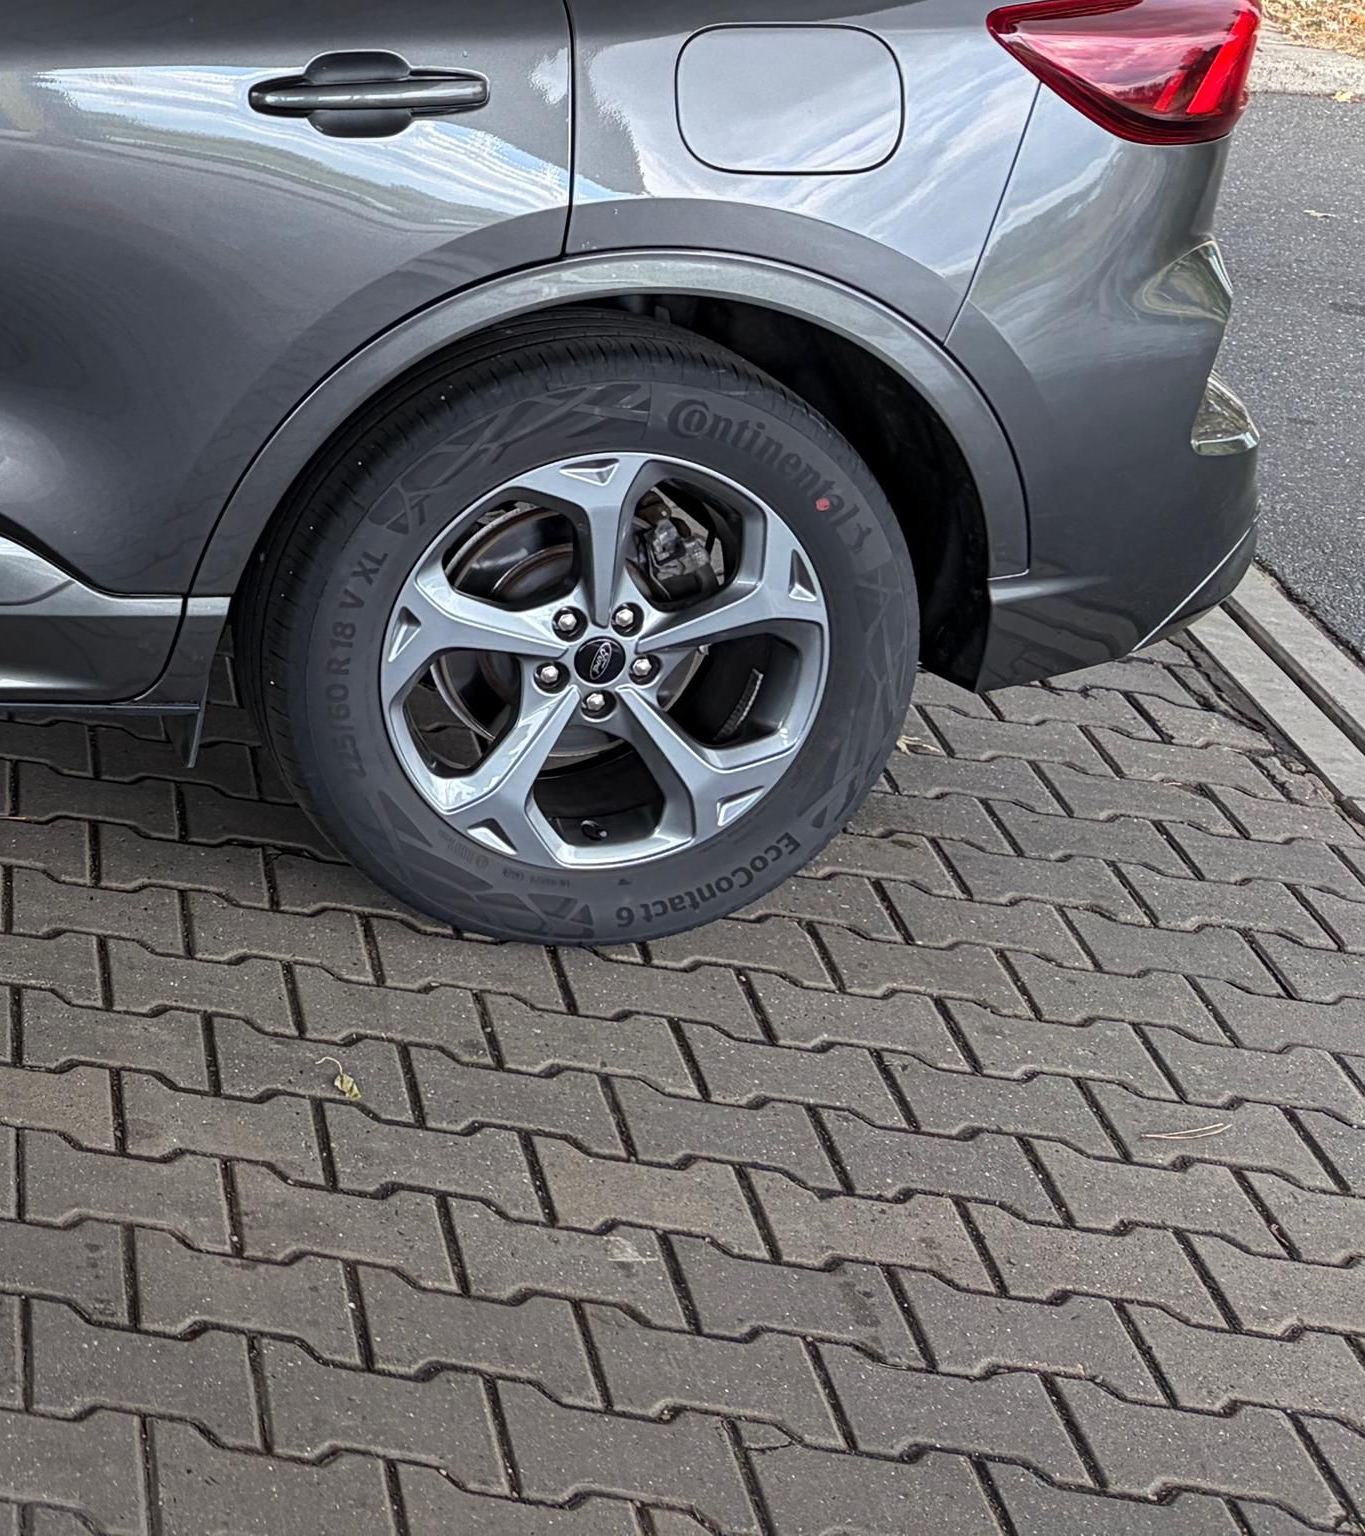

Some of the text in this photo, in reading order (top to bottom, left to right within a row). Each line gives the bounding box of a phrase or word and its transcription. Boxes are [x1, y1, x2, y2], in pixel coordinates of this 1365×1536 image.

[669, 399, 861, 528] Continental
[350, 551, 389, 586] XL
[338, 588, 365, 609] V
[329, 621, 357, 649] 18
[325, 656, 352, 676] R
[591, 646, 611, 676] Ford
[615, 832, 802, 928] EcoContact 6
